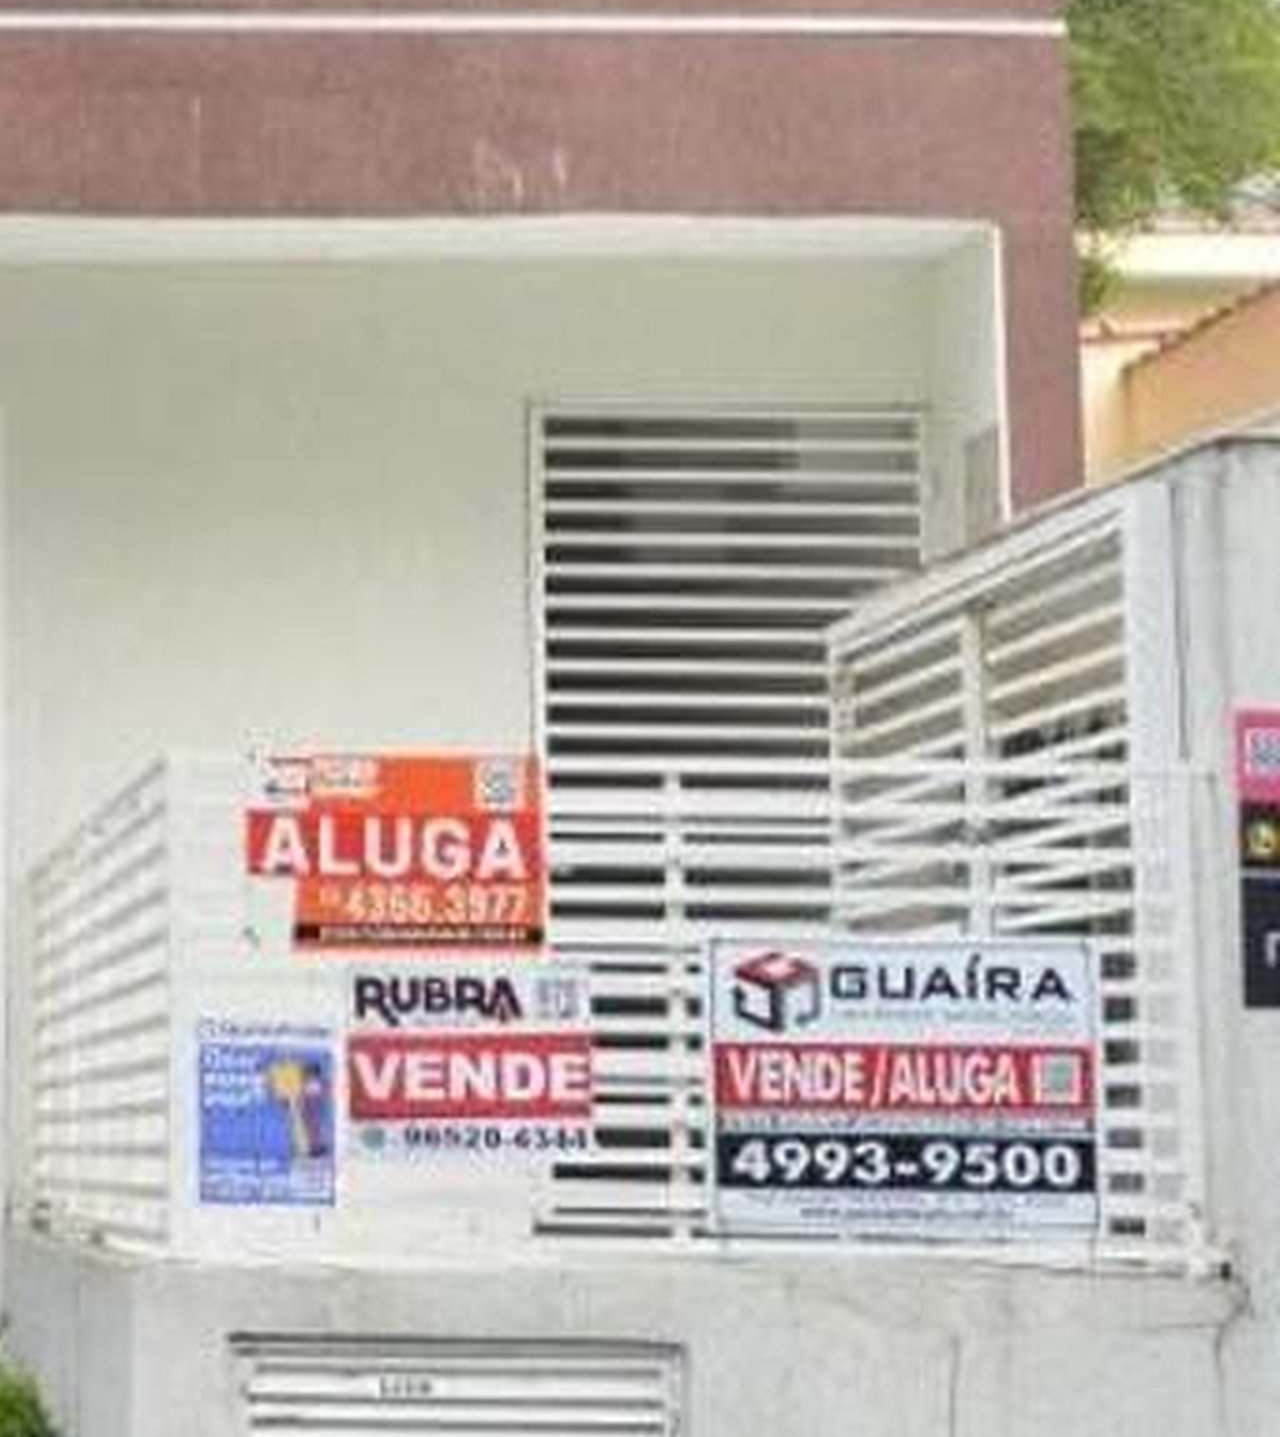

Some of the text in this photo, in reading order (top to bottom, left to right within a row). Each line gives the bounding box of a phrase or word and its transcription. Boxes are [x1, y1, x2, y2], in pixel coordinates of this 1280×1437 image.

[262, 815, 531, 878] ALUGA
[354, 977, 522, 1025] RUBRA
[829, 952, 1074, 1001] GUAÍRA
[352, 1051, 590, 1100] VENDE
[732, 1140, 1082, 1186] 4993-9500
